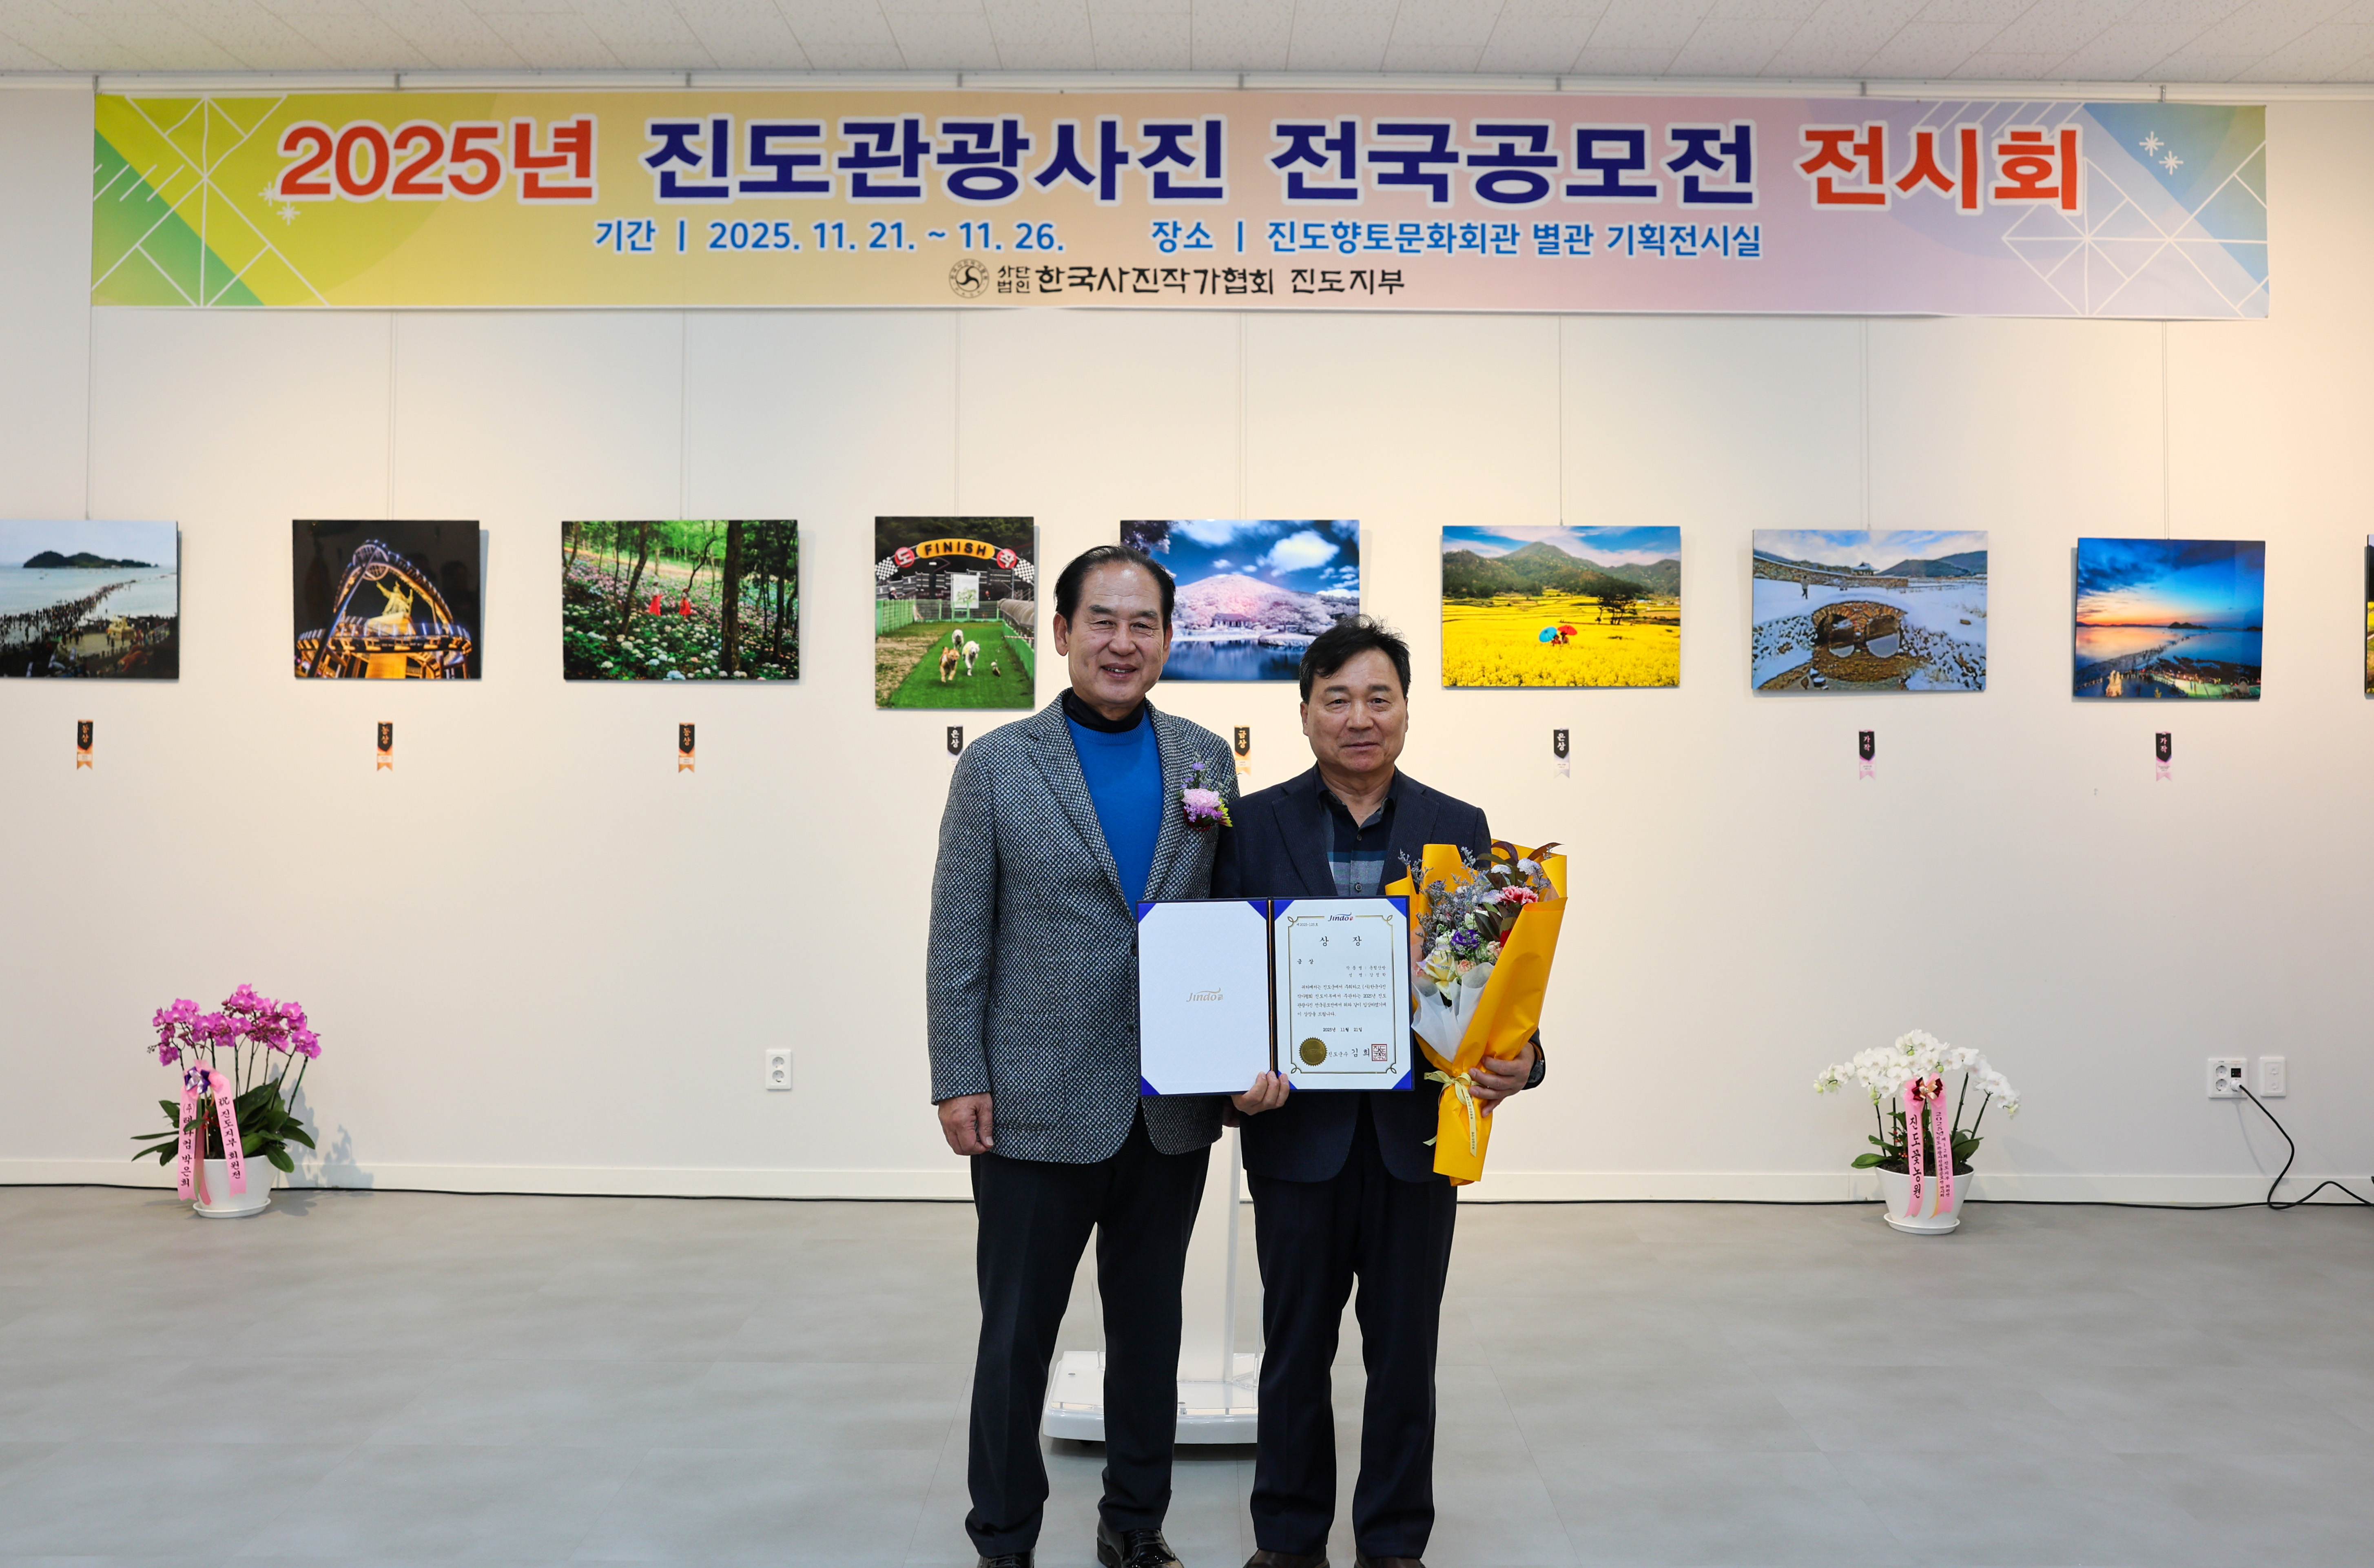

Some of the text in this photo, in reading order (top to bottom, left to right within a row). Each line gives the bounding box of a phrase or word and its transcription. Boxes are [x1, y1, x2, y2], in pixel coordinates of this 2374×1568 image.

[281, 119, 2077, 210] 2025년 진도관광사진 전국공모전 전시회
[596, 220, 656, 252] 기간
[709, 221, 800, 250] 2025.
[814, 222, 855, 250] 11.
[869, 221, 915, 250] 21.
[959, 222, 1001, 250] 11.
[1015, 223, 1063, 251] 26.
[1152, 221, 1214, 253] 장소
[1268, 221, 1521, 255] 진도향토문화회관
[1533, 223, 1594, 255] 별관
[1607, 223, 1761, 257] 기획전시실
[998, 280, 1030, 294] 법인
[1035, 265, 1274, 295] 한국사진작가협회
[1291, 268, 1406, 296] 진도지부
[924, 541, 987, 556] FINISH
[951, 729, 960, 749] 은상
[1238, 730, 1248, 749] 금상
[1557, 732, 1566, 751] 은상
[1863, 735, 1871, 753] 가작
[2160, 737, 2168, 754] 가작
[218, 1096, 230, 1107] 祝
[221, 1109, 241, 1179] 진도지부 회원전
[1909, 1114, 1922, 1198] 진도꽃농원
